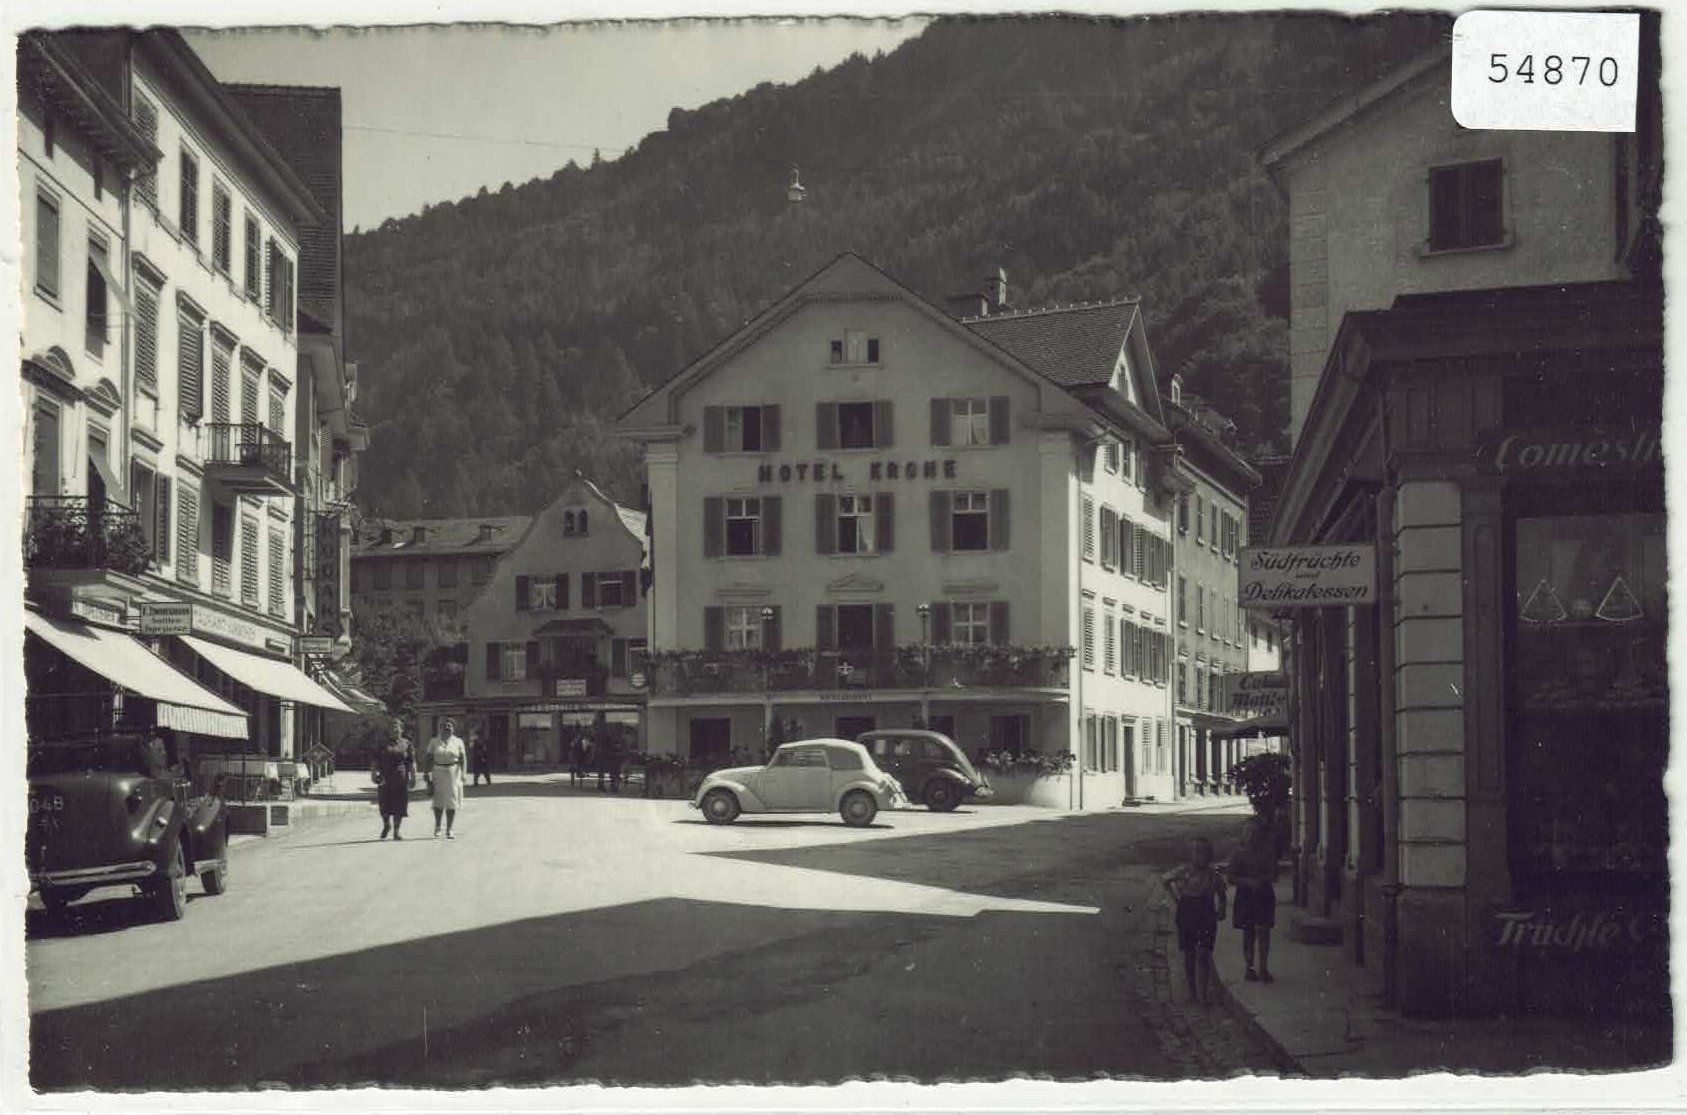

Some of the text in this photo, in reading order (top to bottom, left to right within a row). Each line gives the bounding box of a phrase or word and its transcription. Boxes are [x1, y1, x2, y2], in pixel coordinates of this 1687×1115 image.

[757, 459, 957, 483] HOTEL KRONE
[1250, 551, 1361, 573] Südfrüchte
[1245, 580, 1369, 600] Delikatessen
